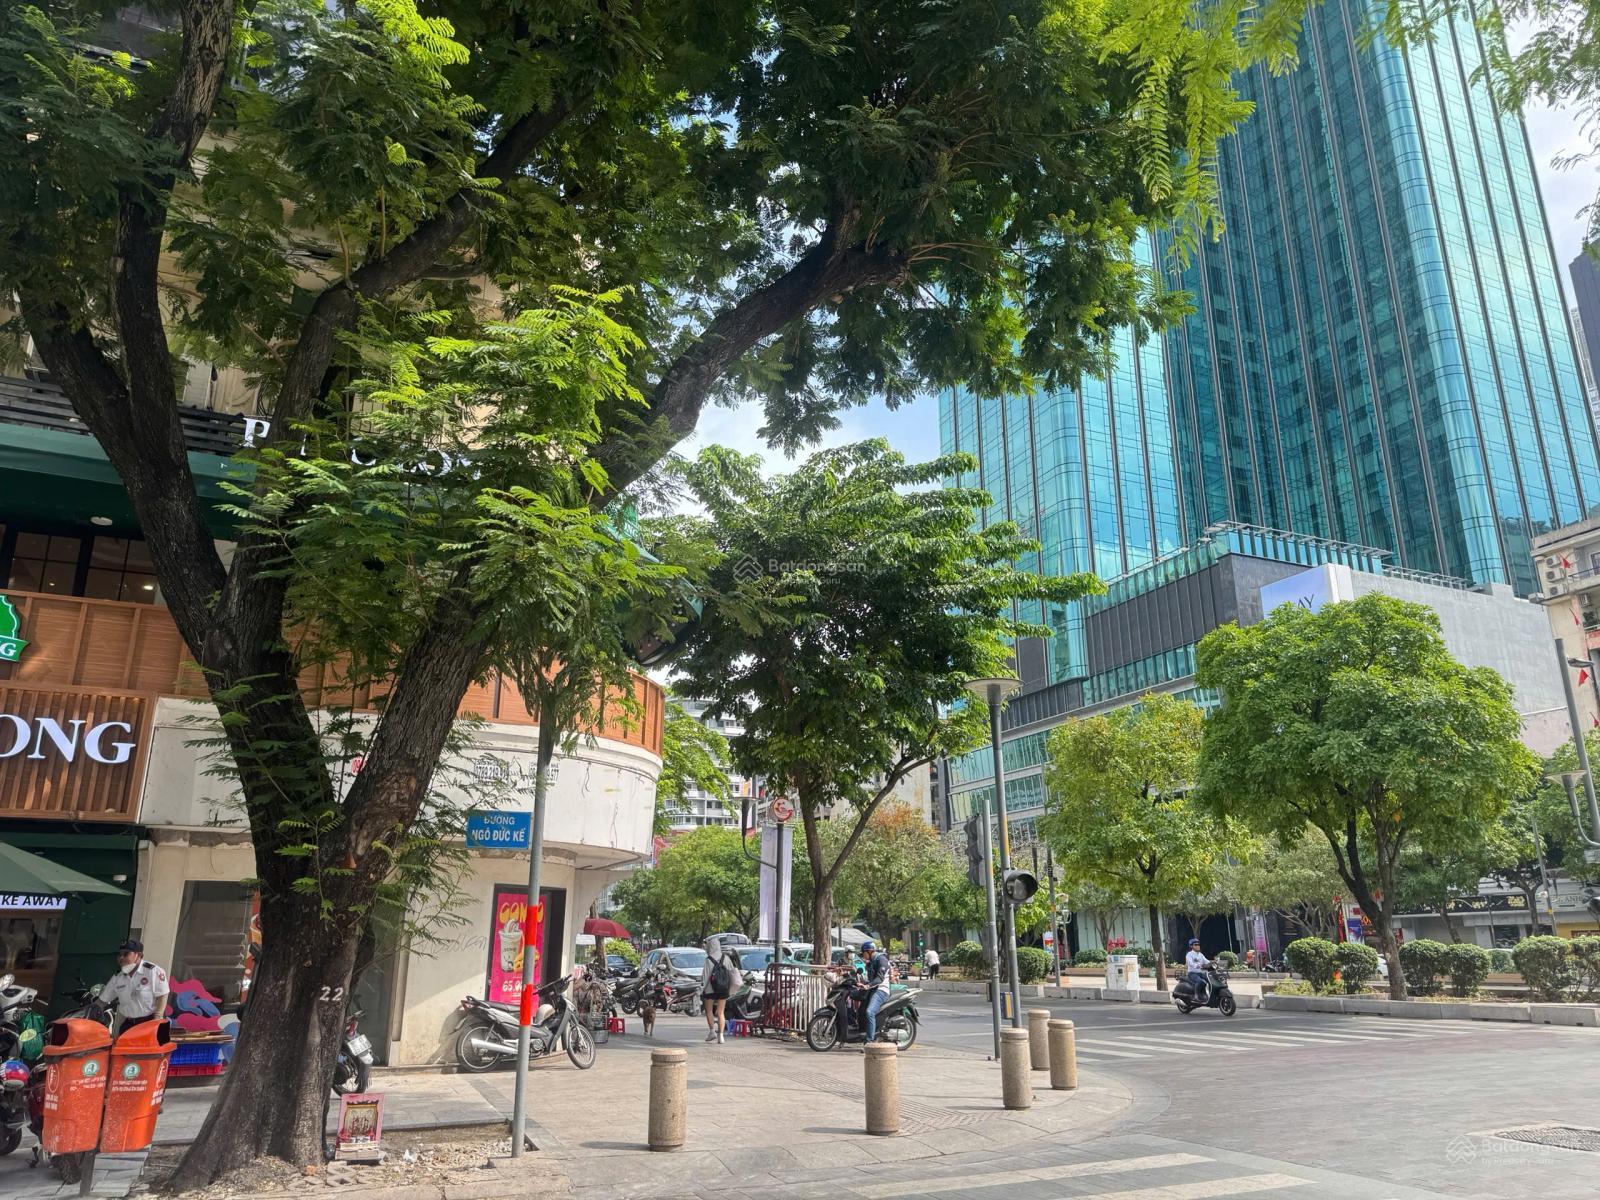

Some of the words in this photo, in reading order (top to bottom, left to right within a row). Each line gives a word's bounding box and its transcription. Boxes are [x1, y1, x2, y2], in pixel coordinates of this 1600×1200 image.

[492, 827, 511, 842] ĐỨC
[22, 895, 64, 907] AWAY
[320, 986, 344, 1001] 22
